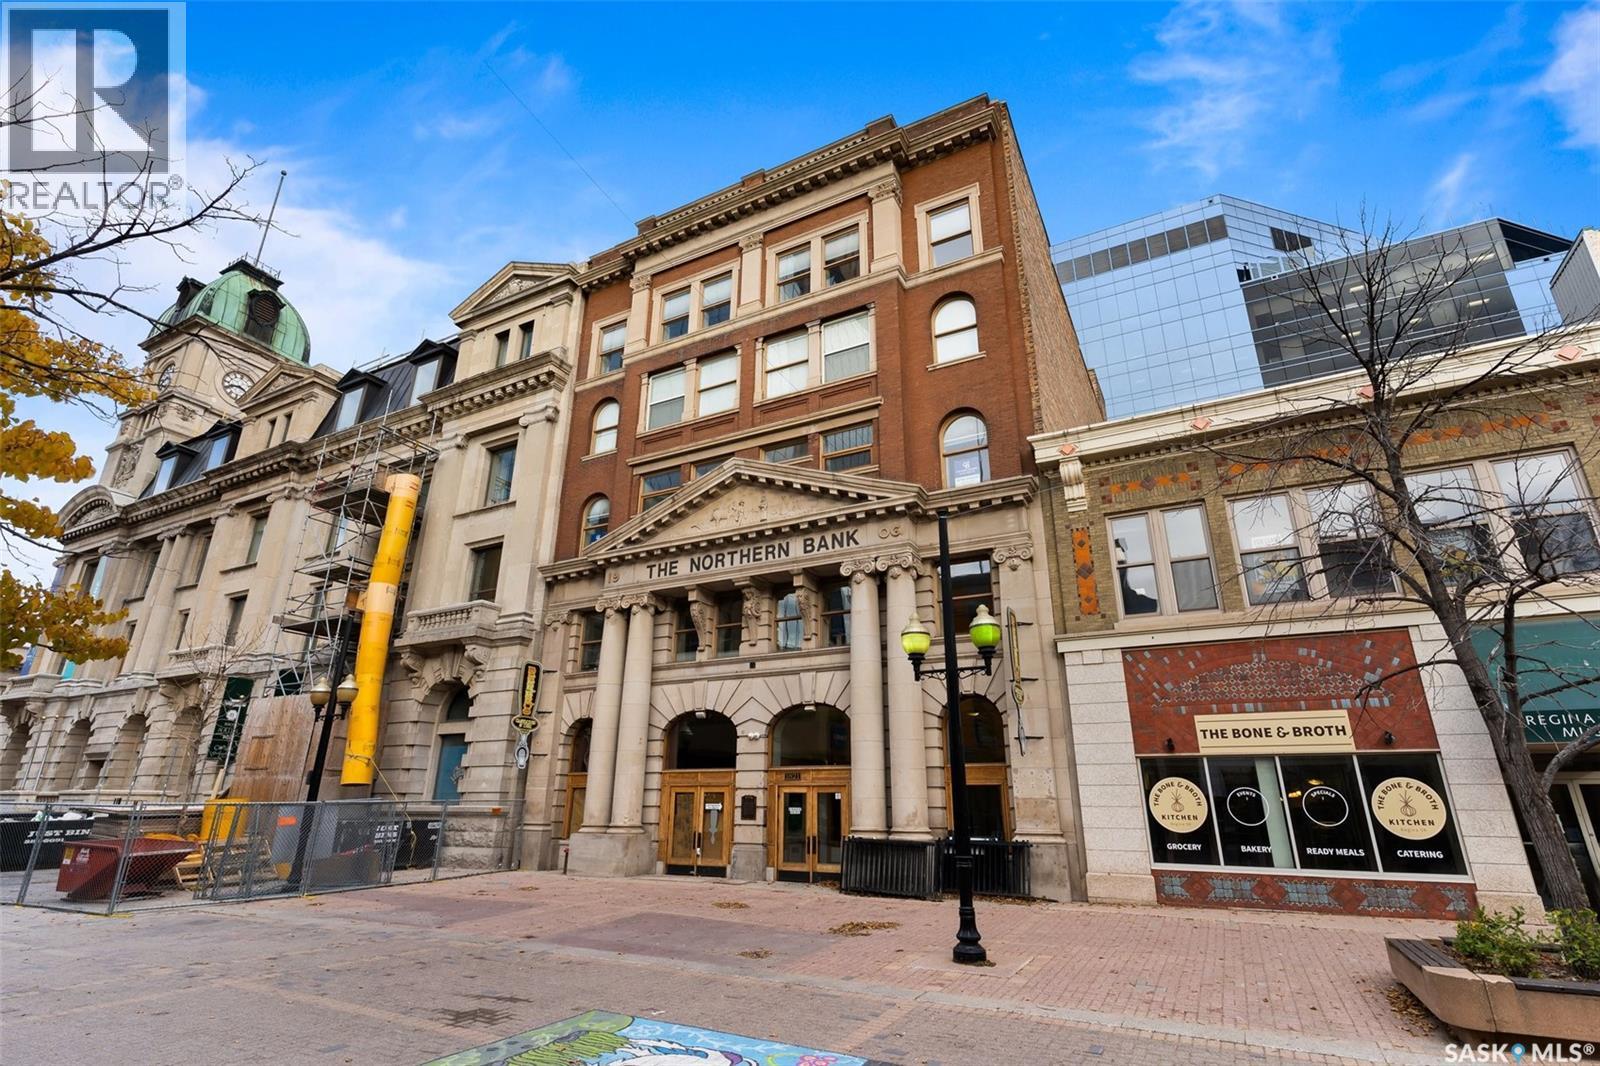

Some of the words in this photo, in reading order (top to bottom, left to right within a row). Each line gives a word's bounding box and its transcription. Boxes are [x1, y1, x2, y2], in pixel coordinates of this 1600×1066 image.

[647, 559, 679, 579] THE
[689, 541, 790, 573] NORTHERN
[803, 529, 859, 554] BANK
[1525, 713, 1596, 726] REGINA
[1200, 728, 1228, 739] THE
[1232, 727, 1273, 738] BONE
[1276, 726, 1290, 738] &
[1292, 725, 1347, 737] BROTH
[1381, 782, 1403, 796] BONE
[1405, 782, 1413, 790] &
[1153, 793, 1161, 807] THE
[1158, 782, 1175, 794] BONE
[1184, 785, 1203, 807] BROTH
[1236, 790, 1256, 798] EVENTS
[1310, 789, 1336, 799] SPECIALS
[1415, 786, 1439, 810] BROTH
[1377, 795, 1386, 810] THE
[1389, 818, 1435, 826] KITCHEN
[1167, 843, 1202, 851] GROCERY
[1241, 845, 1272, 853] BAKERY
[1306, 847, 1334, 856] READY
[1336, 848, 1365, 857] MEALS
[1397, 850, 1444, 859] CATERING
